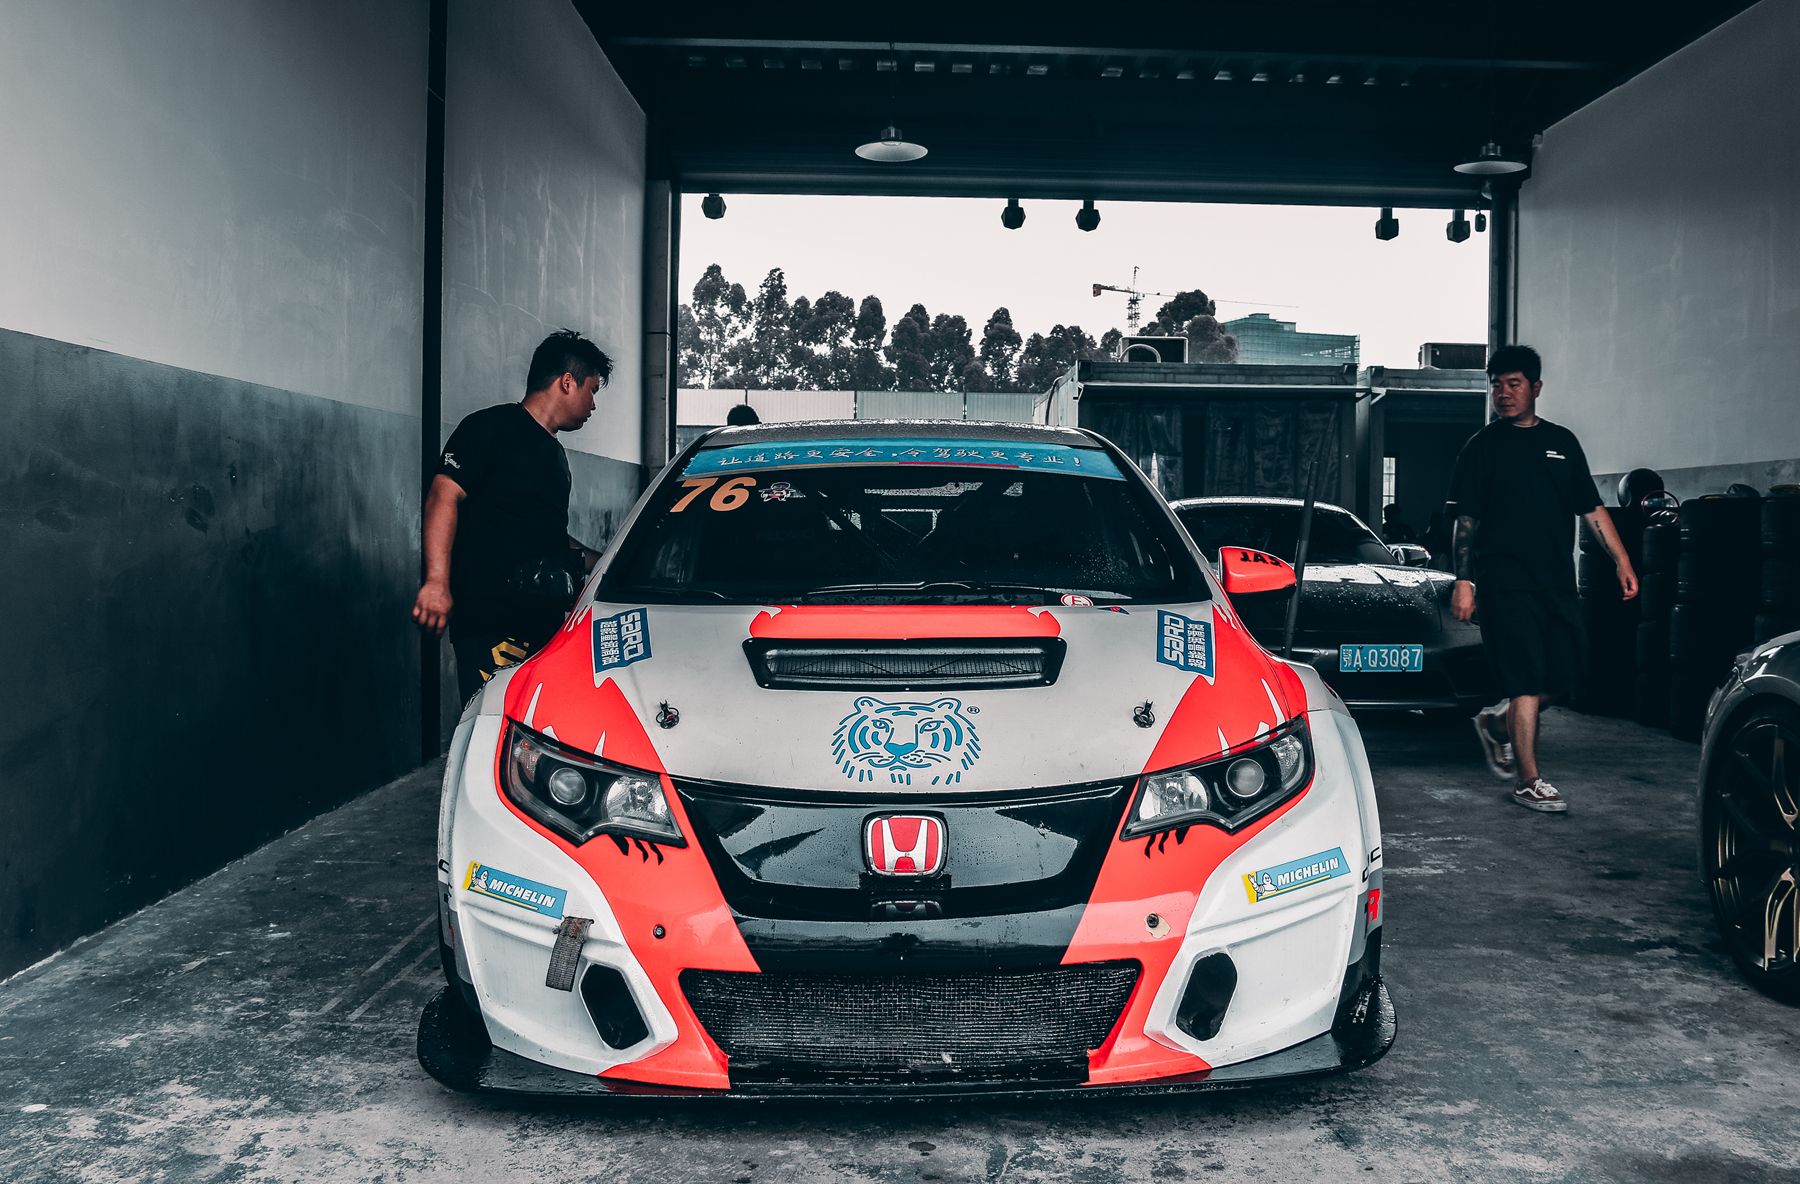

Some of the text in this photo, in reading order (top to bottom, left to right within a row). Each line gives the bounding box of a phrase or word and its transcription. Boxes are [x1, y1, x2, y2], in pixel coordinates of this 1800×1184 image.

[670, 477, 757, 513] 76
[1277, 857, 1340, 886] MICHELIN
[489, 879, 556, 908] MICHELIN
